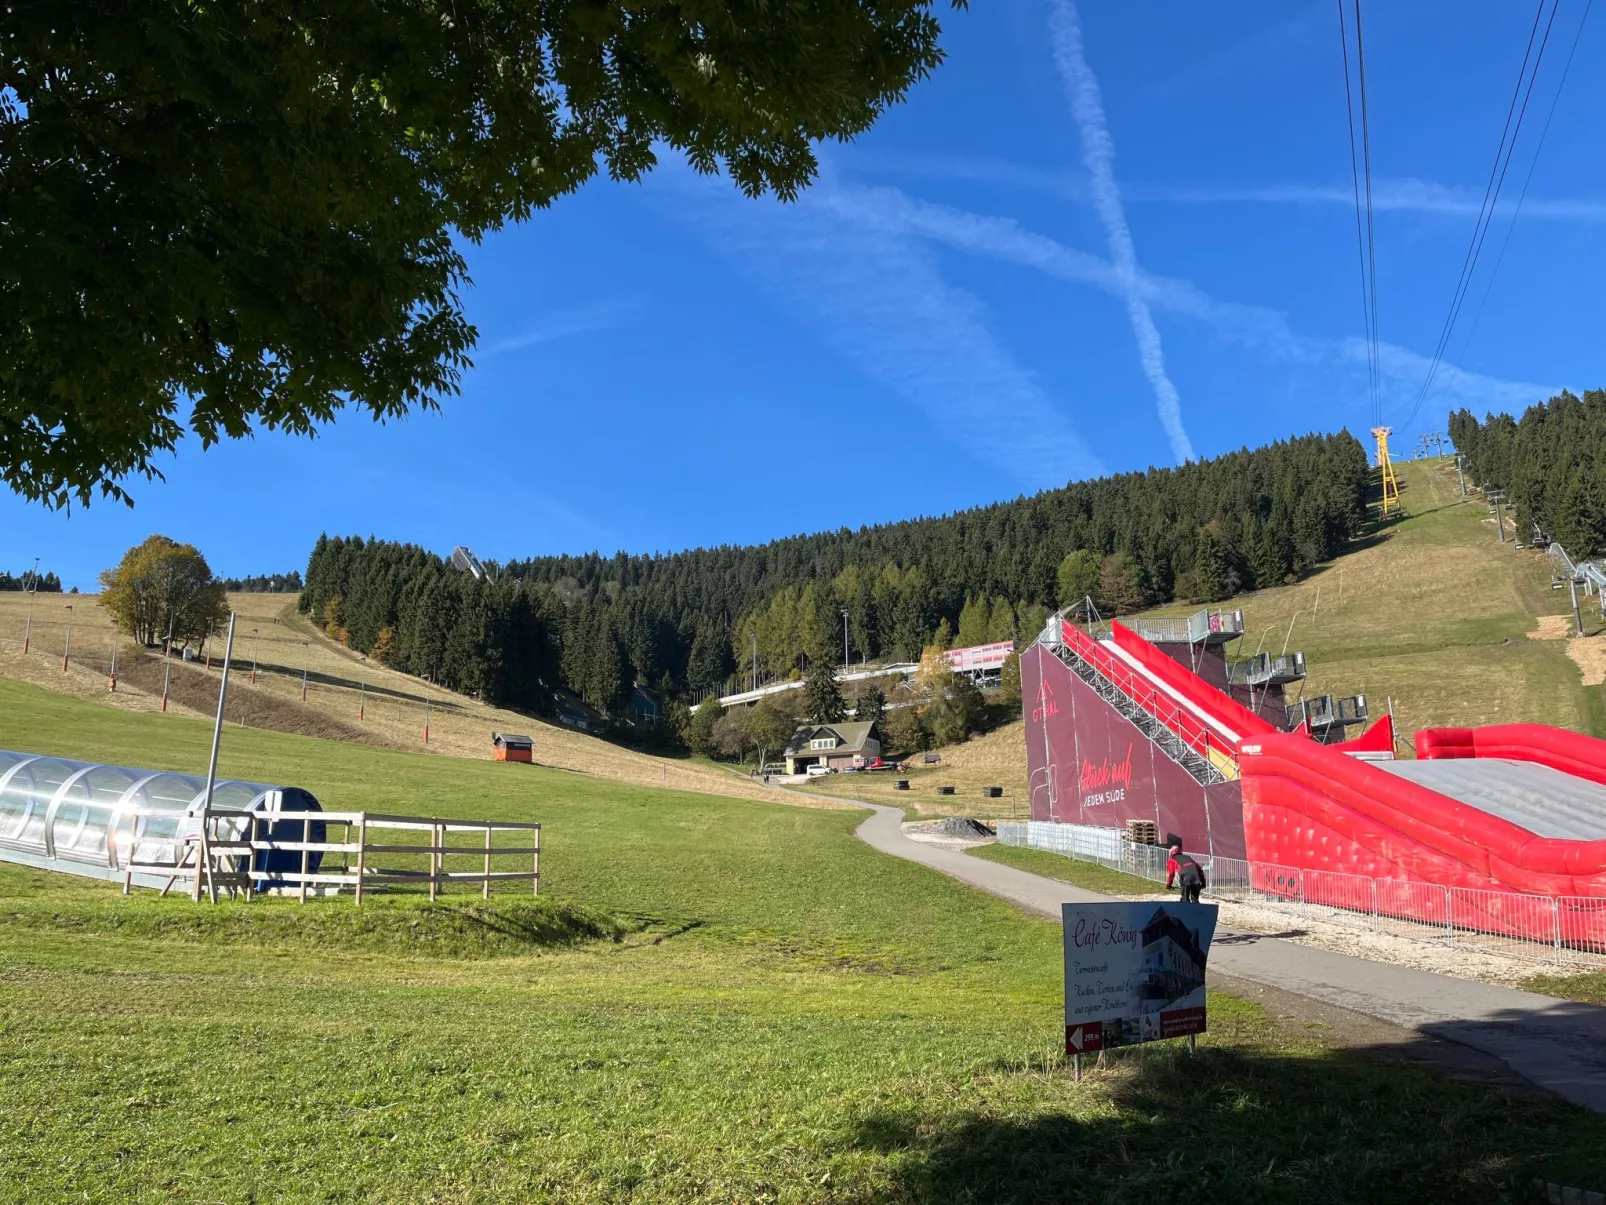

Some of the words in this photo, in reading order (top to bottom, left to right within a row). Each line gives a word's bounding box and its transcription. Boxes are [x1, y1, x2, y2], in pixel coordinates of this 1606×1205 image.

[1083, 792, 1105, 807] JEDEM
[1105, 788, 1125, 803] SLIDE
[1071, 918, 1101, 952] Café
[1102, 918, 1138, 950] König
